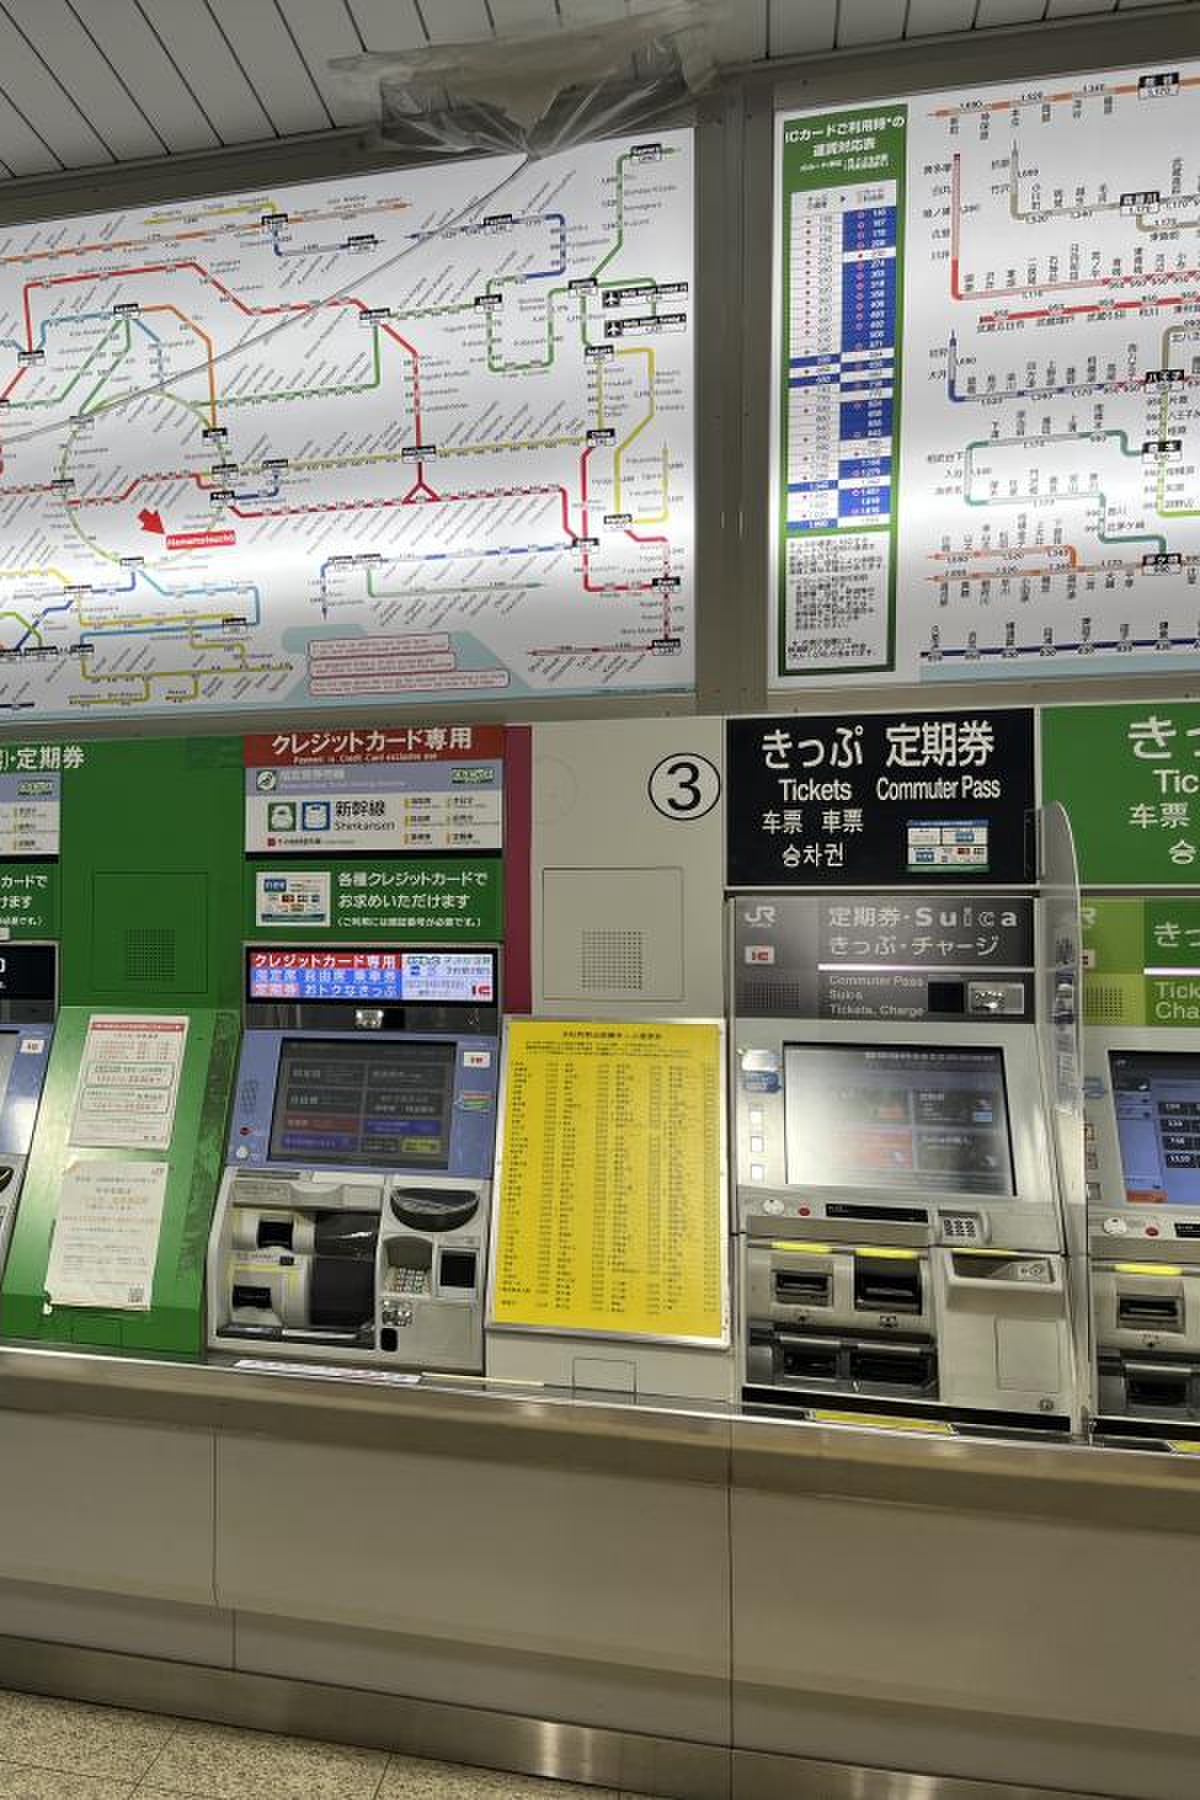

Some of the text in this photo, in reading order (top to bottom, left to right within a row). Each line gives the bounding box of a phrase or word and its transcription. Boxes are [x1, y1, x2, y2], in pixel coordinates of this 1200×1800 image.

[272, 727, 472, 756] クレジットカード専用
[762, 719, 995, 769] きっぷ 定期券
[778, 774, 1001, 801] Tickets Commuter Pass
[335, 799, 386, 817] 新幹線
[1129, 803, 1191, 829] 车票
[762, 808, 863, 835] 车票 車票
[782, 842, 844, 868] 승차권
[337, 871, 488, 888] 各種クレジットカードで
[337, 893, 471, 910] お求めいただけます
[745, 906, 776, 925] JR
[255, 954, 397, 969] クレジットカード専用
[829, 974, 924, 987] Commuter Pass
[878, 1004, 926, 1018] Charge
